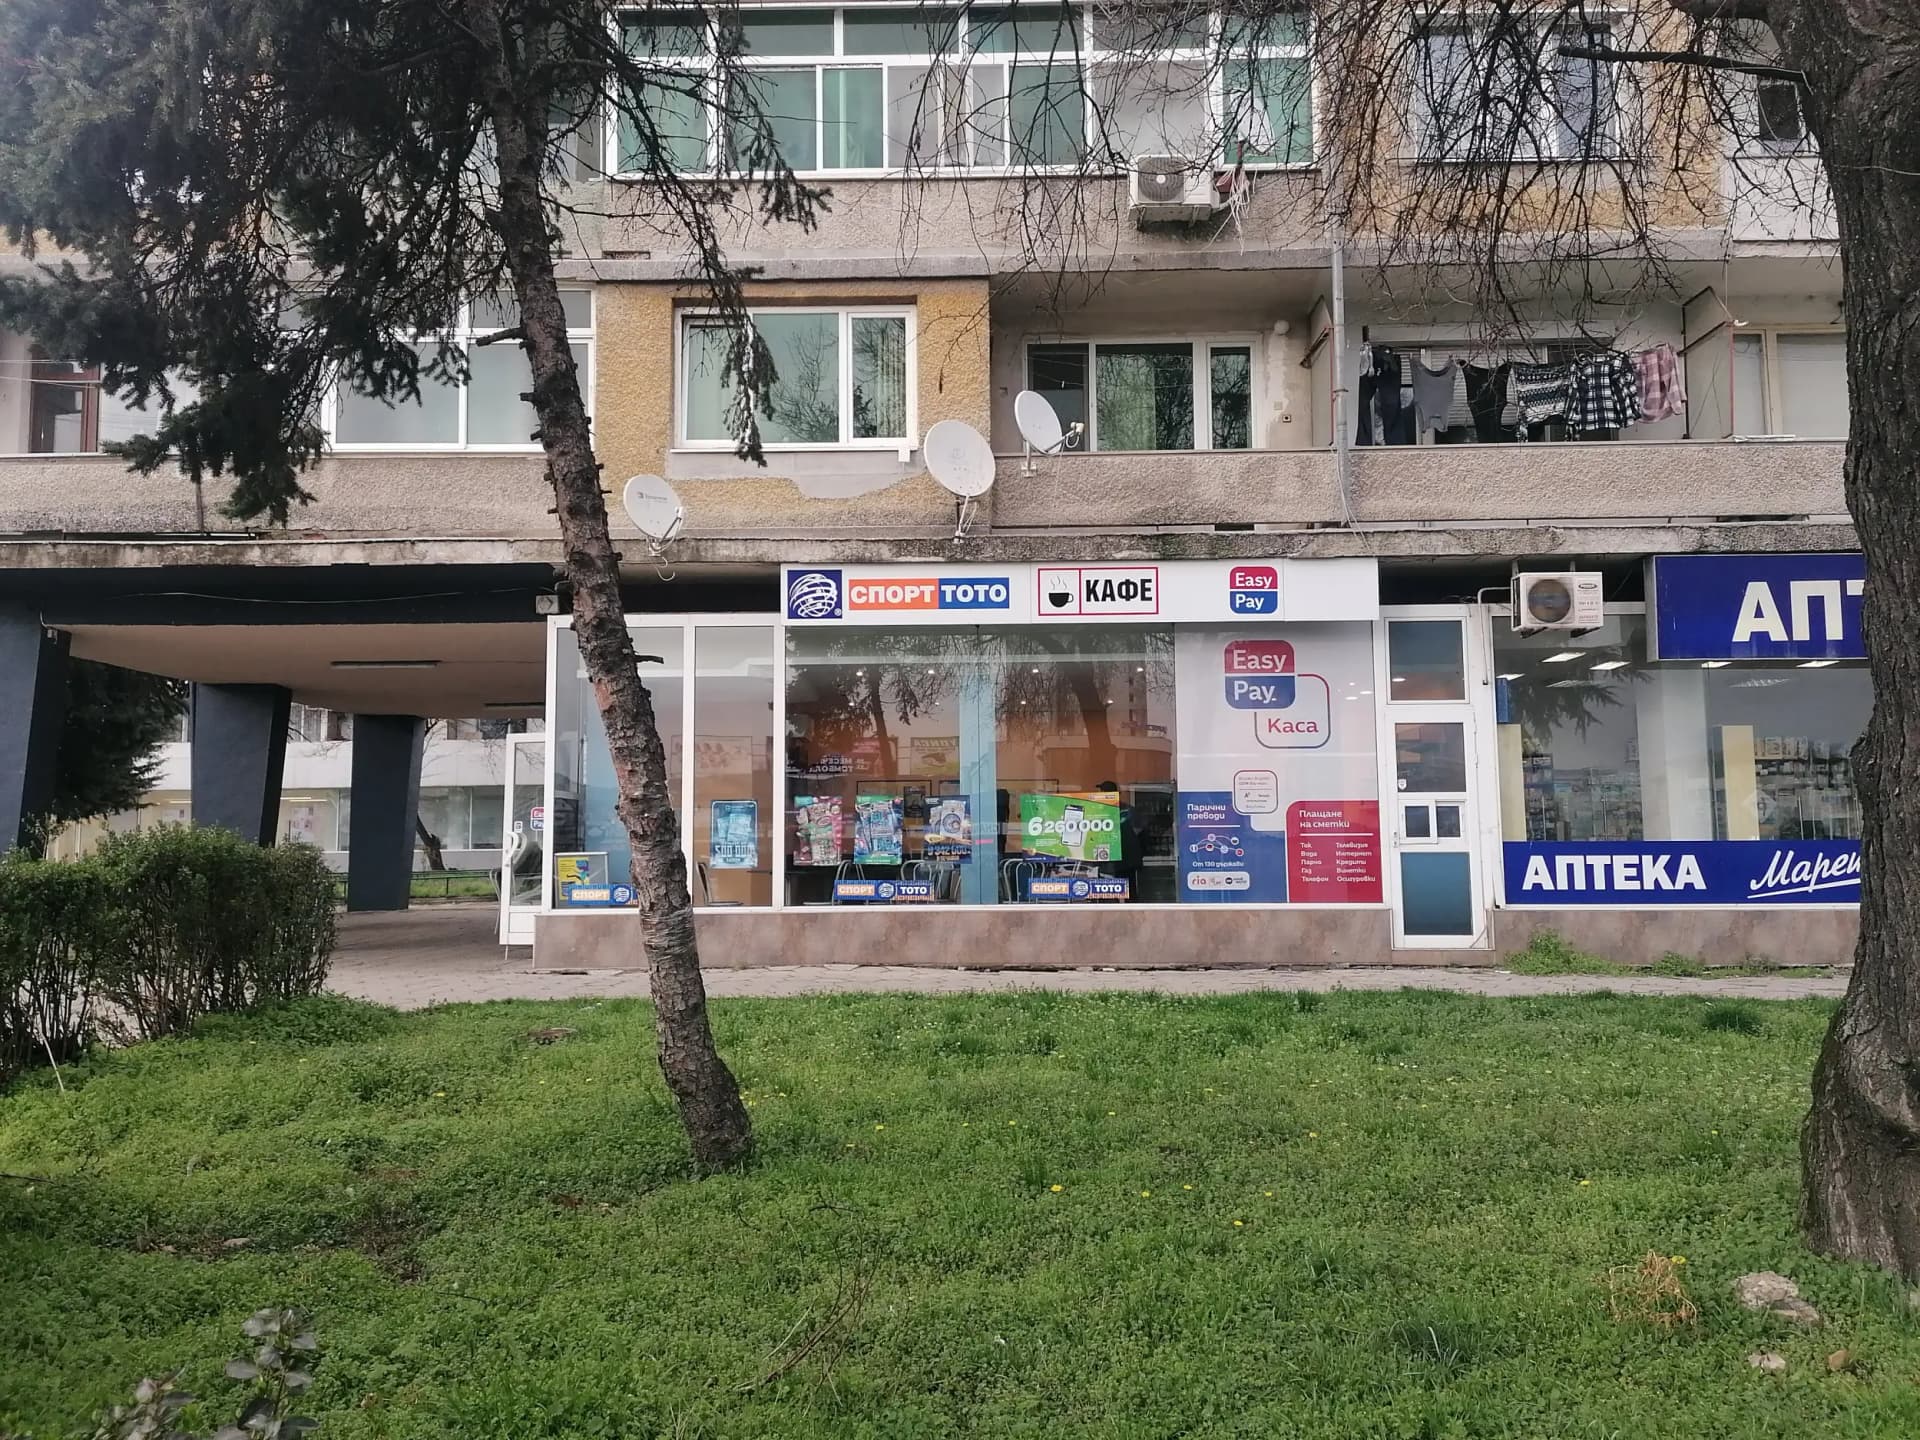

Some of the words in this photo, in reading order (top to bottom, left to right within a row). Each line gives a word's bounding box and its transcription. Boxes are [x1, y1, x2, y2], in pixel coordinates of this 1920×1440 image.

[1235, 573, 1273, 589] Easy
[850, 585, 936, 604] СПОРТ
[941, 584, 1007, 603] ТОТО
[1085, 578, 1153, 602] КАФЕ
[1236, 594, 1264, 610] Pay
[1233, 649, 1287, 672] Easy
[1234, 680, 1276, 703] Pay
[1267, 718, 1320, 733] Каса
[1187, 803, 1226, 812] Парични
[1299, 810, 1342, 818] Плащане
[1187, 812, 1226, 820] преводи
[1313, 820, 1350, 828] сметки
[1522, 854, 1707, 890] АПТЕКА
[838, 885, 873, 895] СПОРТ
[900, 886, 927, 895] ТОТО
[1032, 883, 1068, 893] СПОРТ
[1095, 884, 1122, 893] ТОТО
